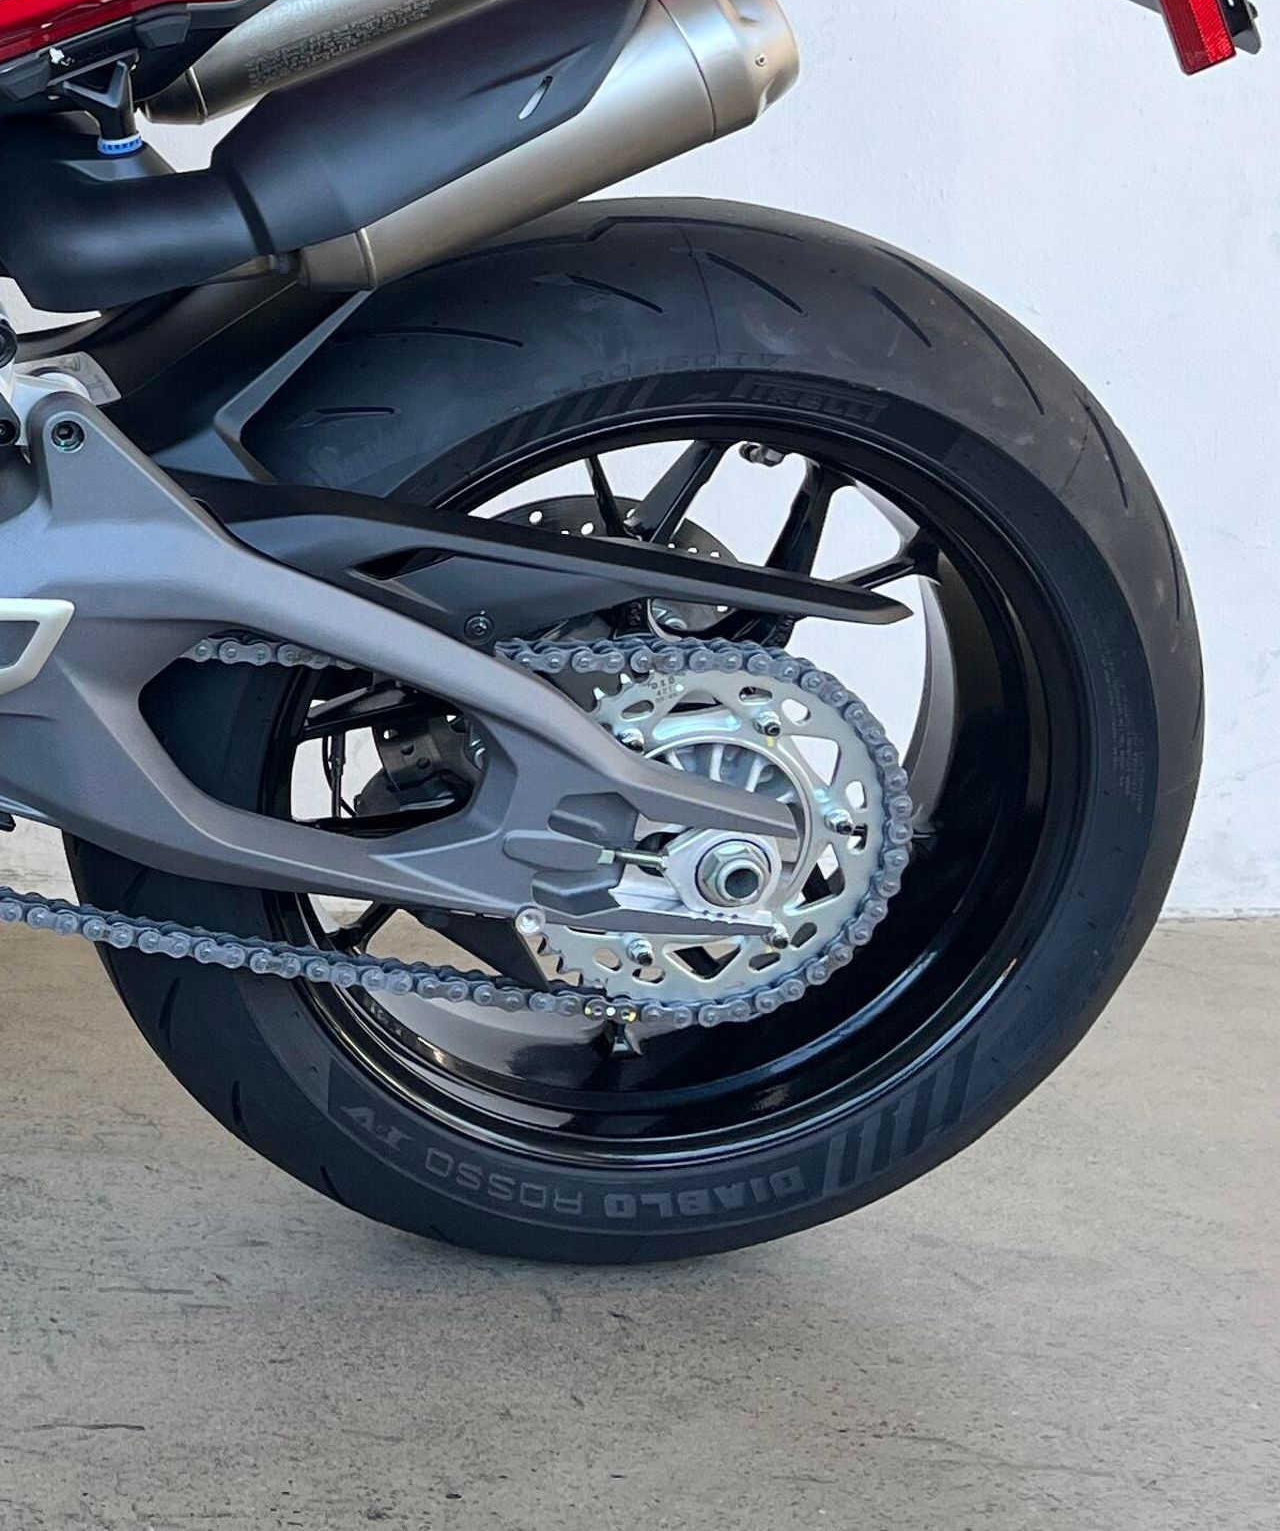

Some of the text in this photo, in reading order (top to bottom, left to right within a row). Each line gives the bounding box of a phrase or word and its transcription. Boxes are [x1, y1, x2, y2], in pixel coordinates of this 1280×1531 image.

[339, 1104, 805, 1219] DIABLO ROSSO IV
